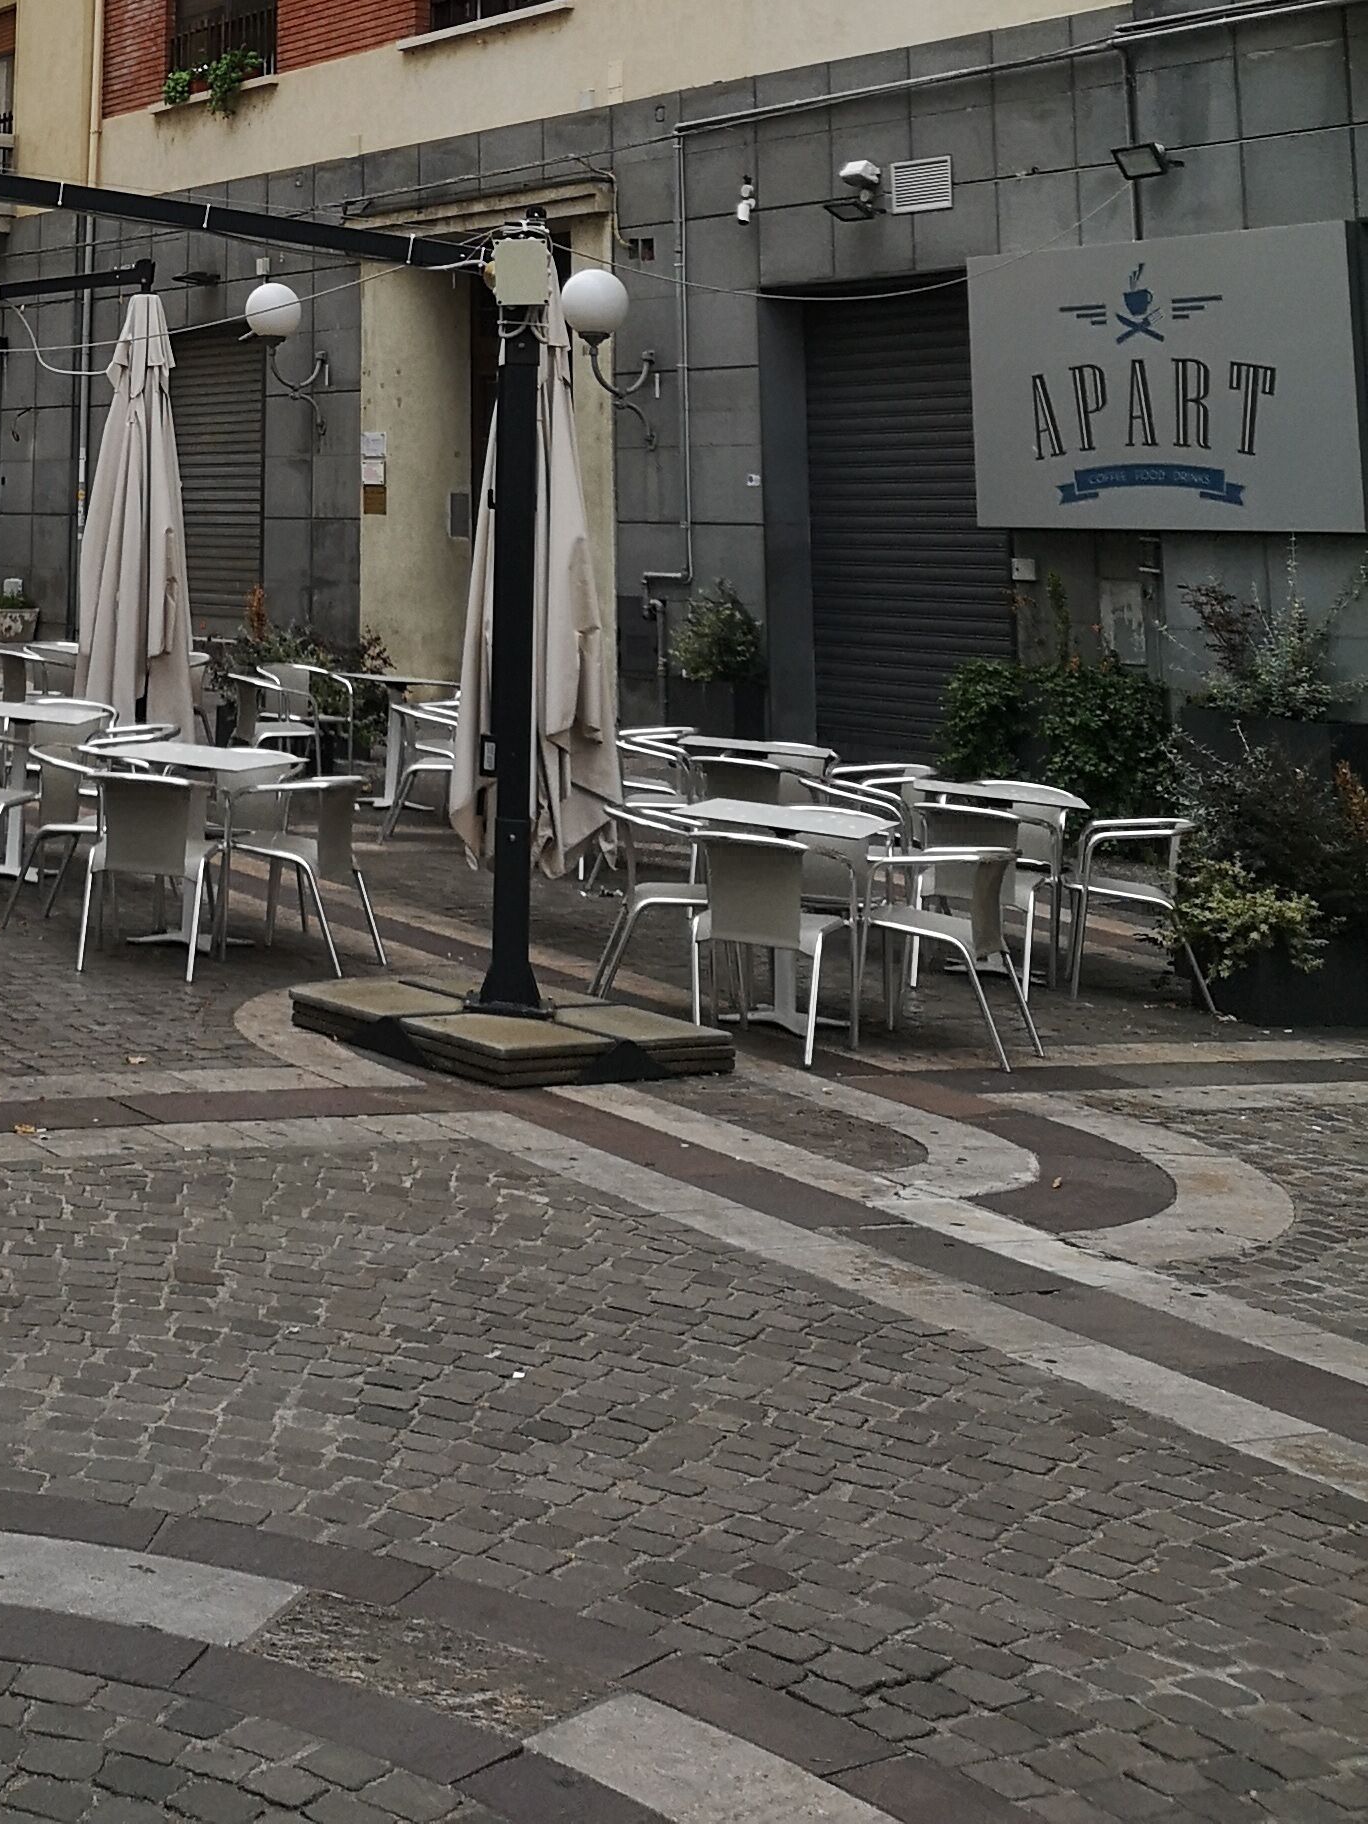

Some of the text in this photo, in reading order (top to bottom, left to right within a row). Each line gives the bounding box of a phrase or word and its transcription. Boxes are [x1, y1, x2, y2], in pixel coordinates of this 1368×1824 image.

[1032, 358, 1276, 460] APART
[1135, 468, 1166, 482] FOOD
[1173, 470, 1211, 485] DRINKS
